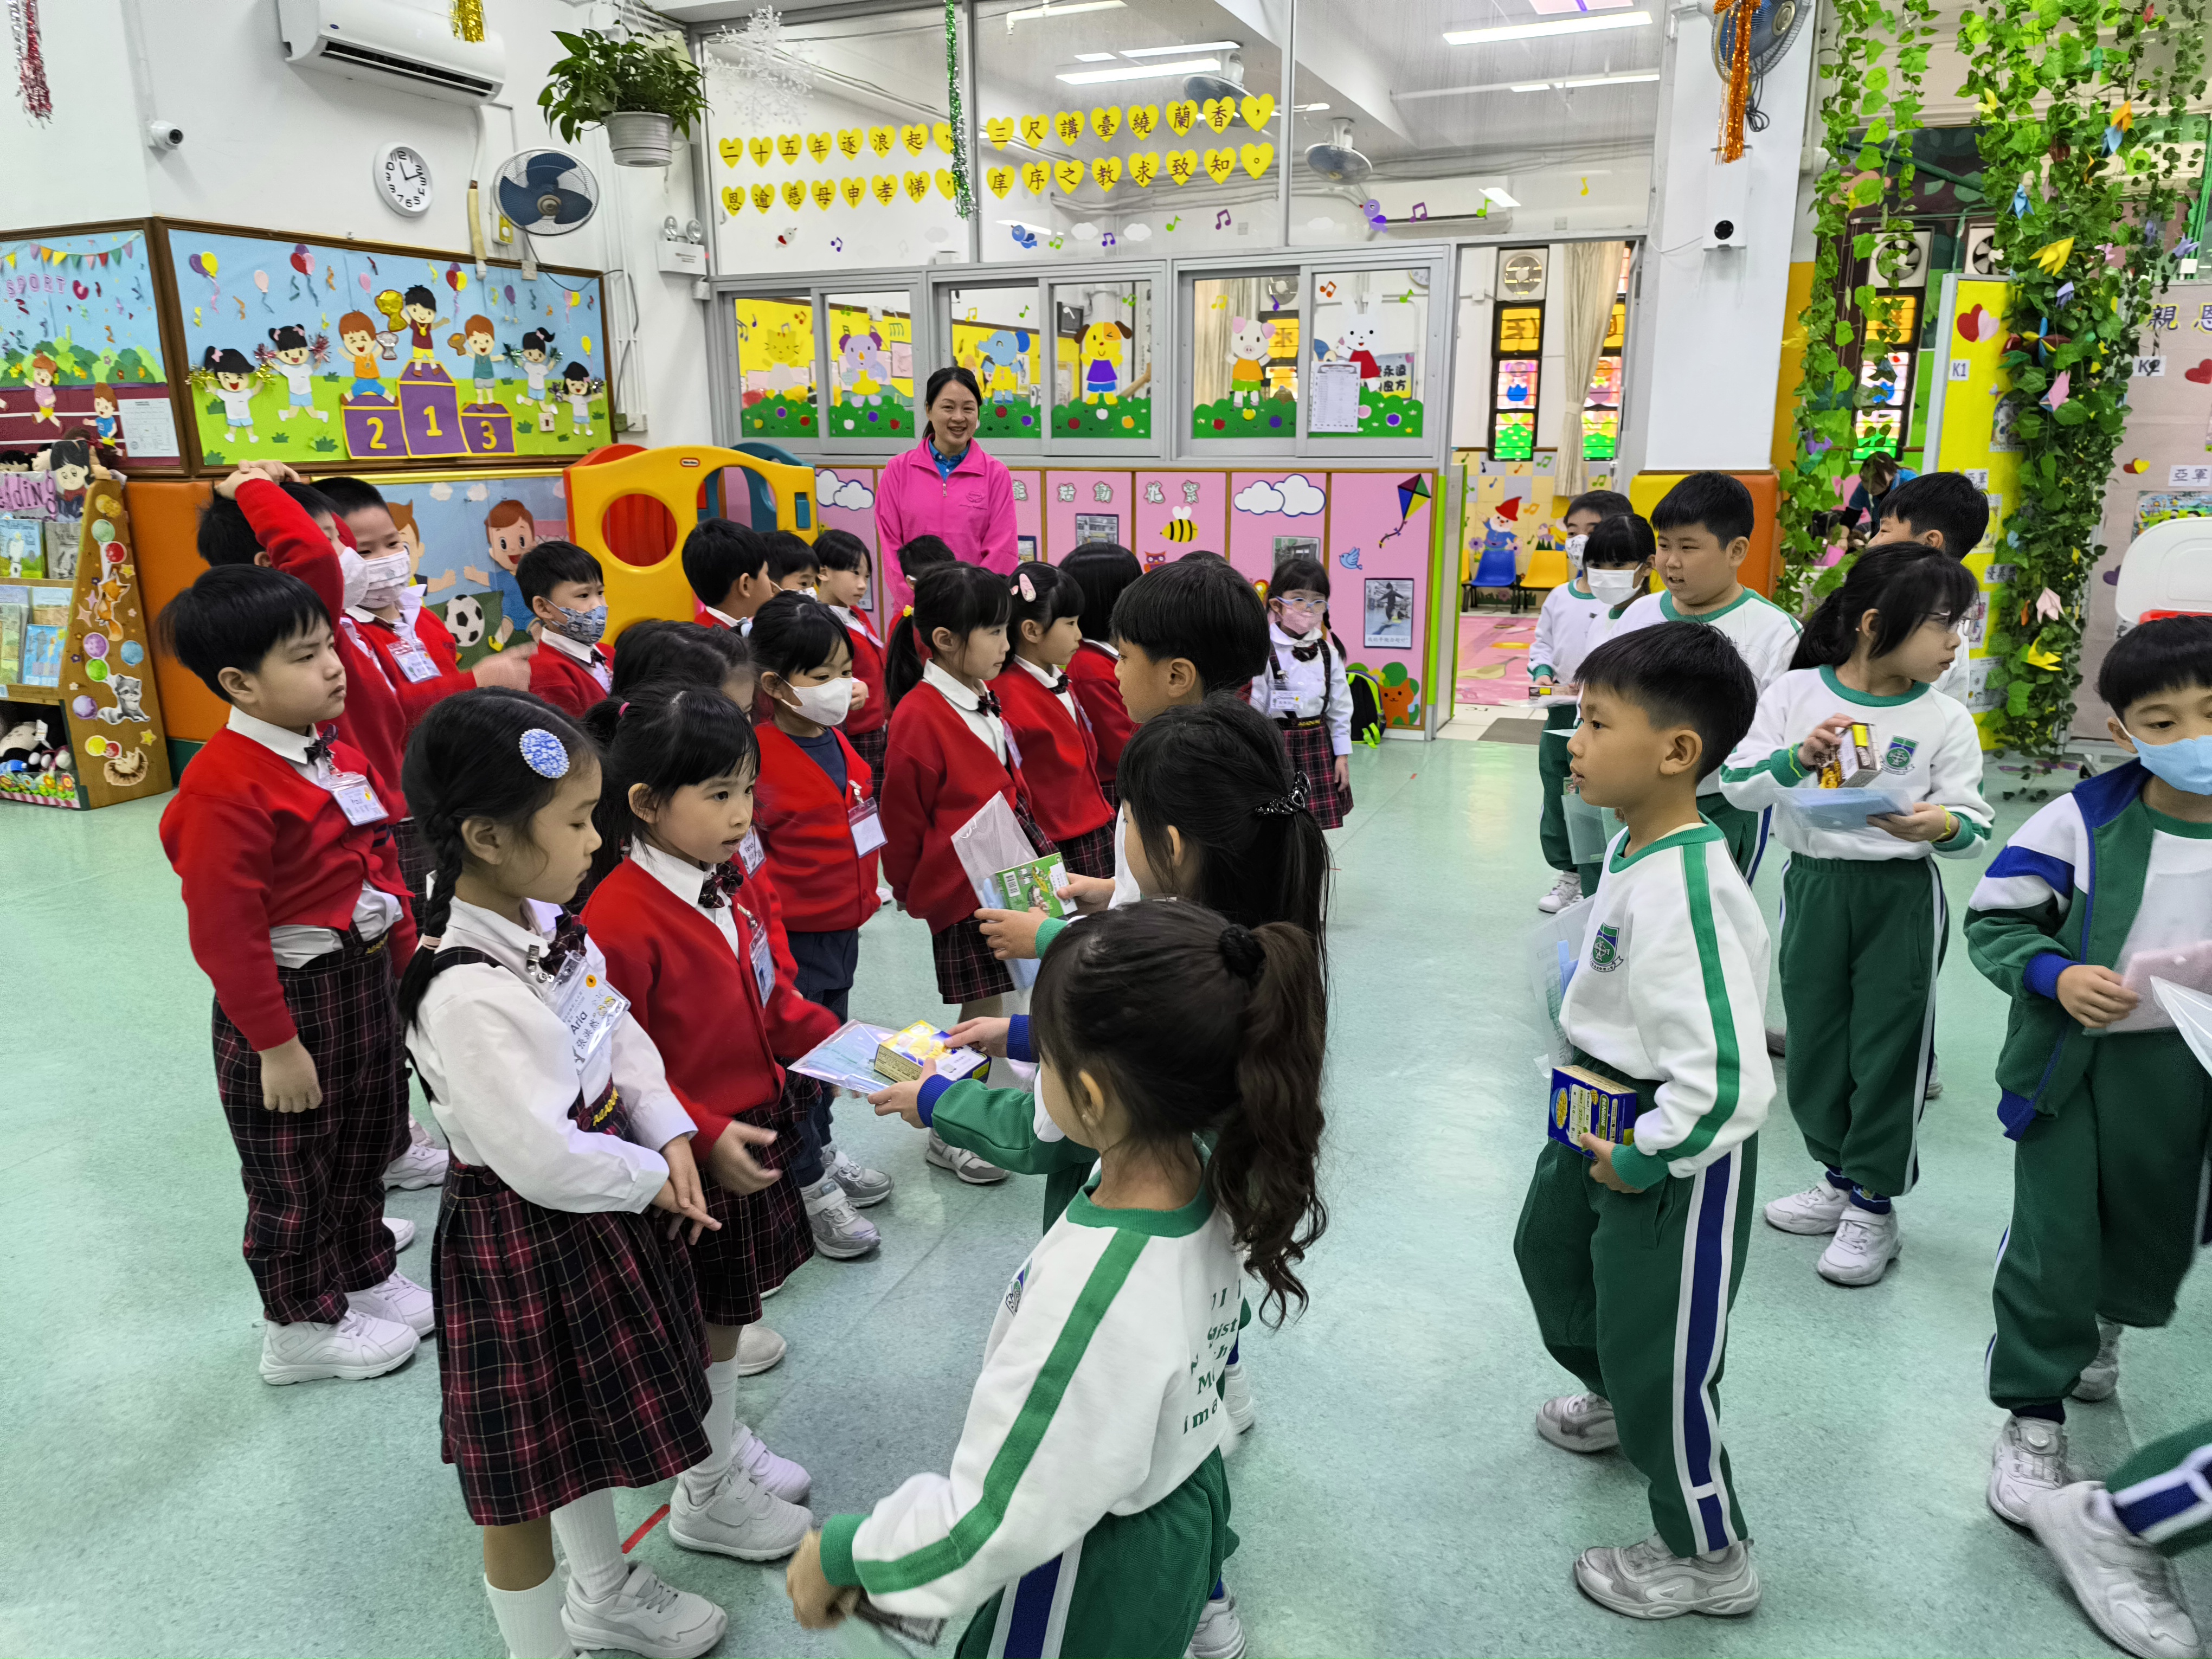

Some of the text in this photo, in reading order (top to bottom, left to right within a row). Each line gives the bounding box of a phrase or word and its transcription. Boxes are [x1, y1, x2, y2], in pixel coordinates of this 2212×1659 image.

[397, 194, 404, 202] 7
[405, 199, 413, 208] 6
[413, 196, 421, 204] 5
[7, 273, 66, 298] SPORT
[1952, 363, 1965, 376] K1
[423, 406, 443, 436] 1
[366, 417, 387, 449] 2
[481, 420, 498, 450] 3
[2172, 468, 2208, 483] 亞軍
[570, 1011, 588, 1035] Aria
